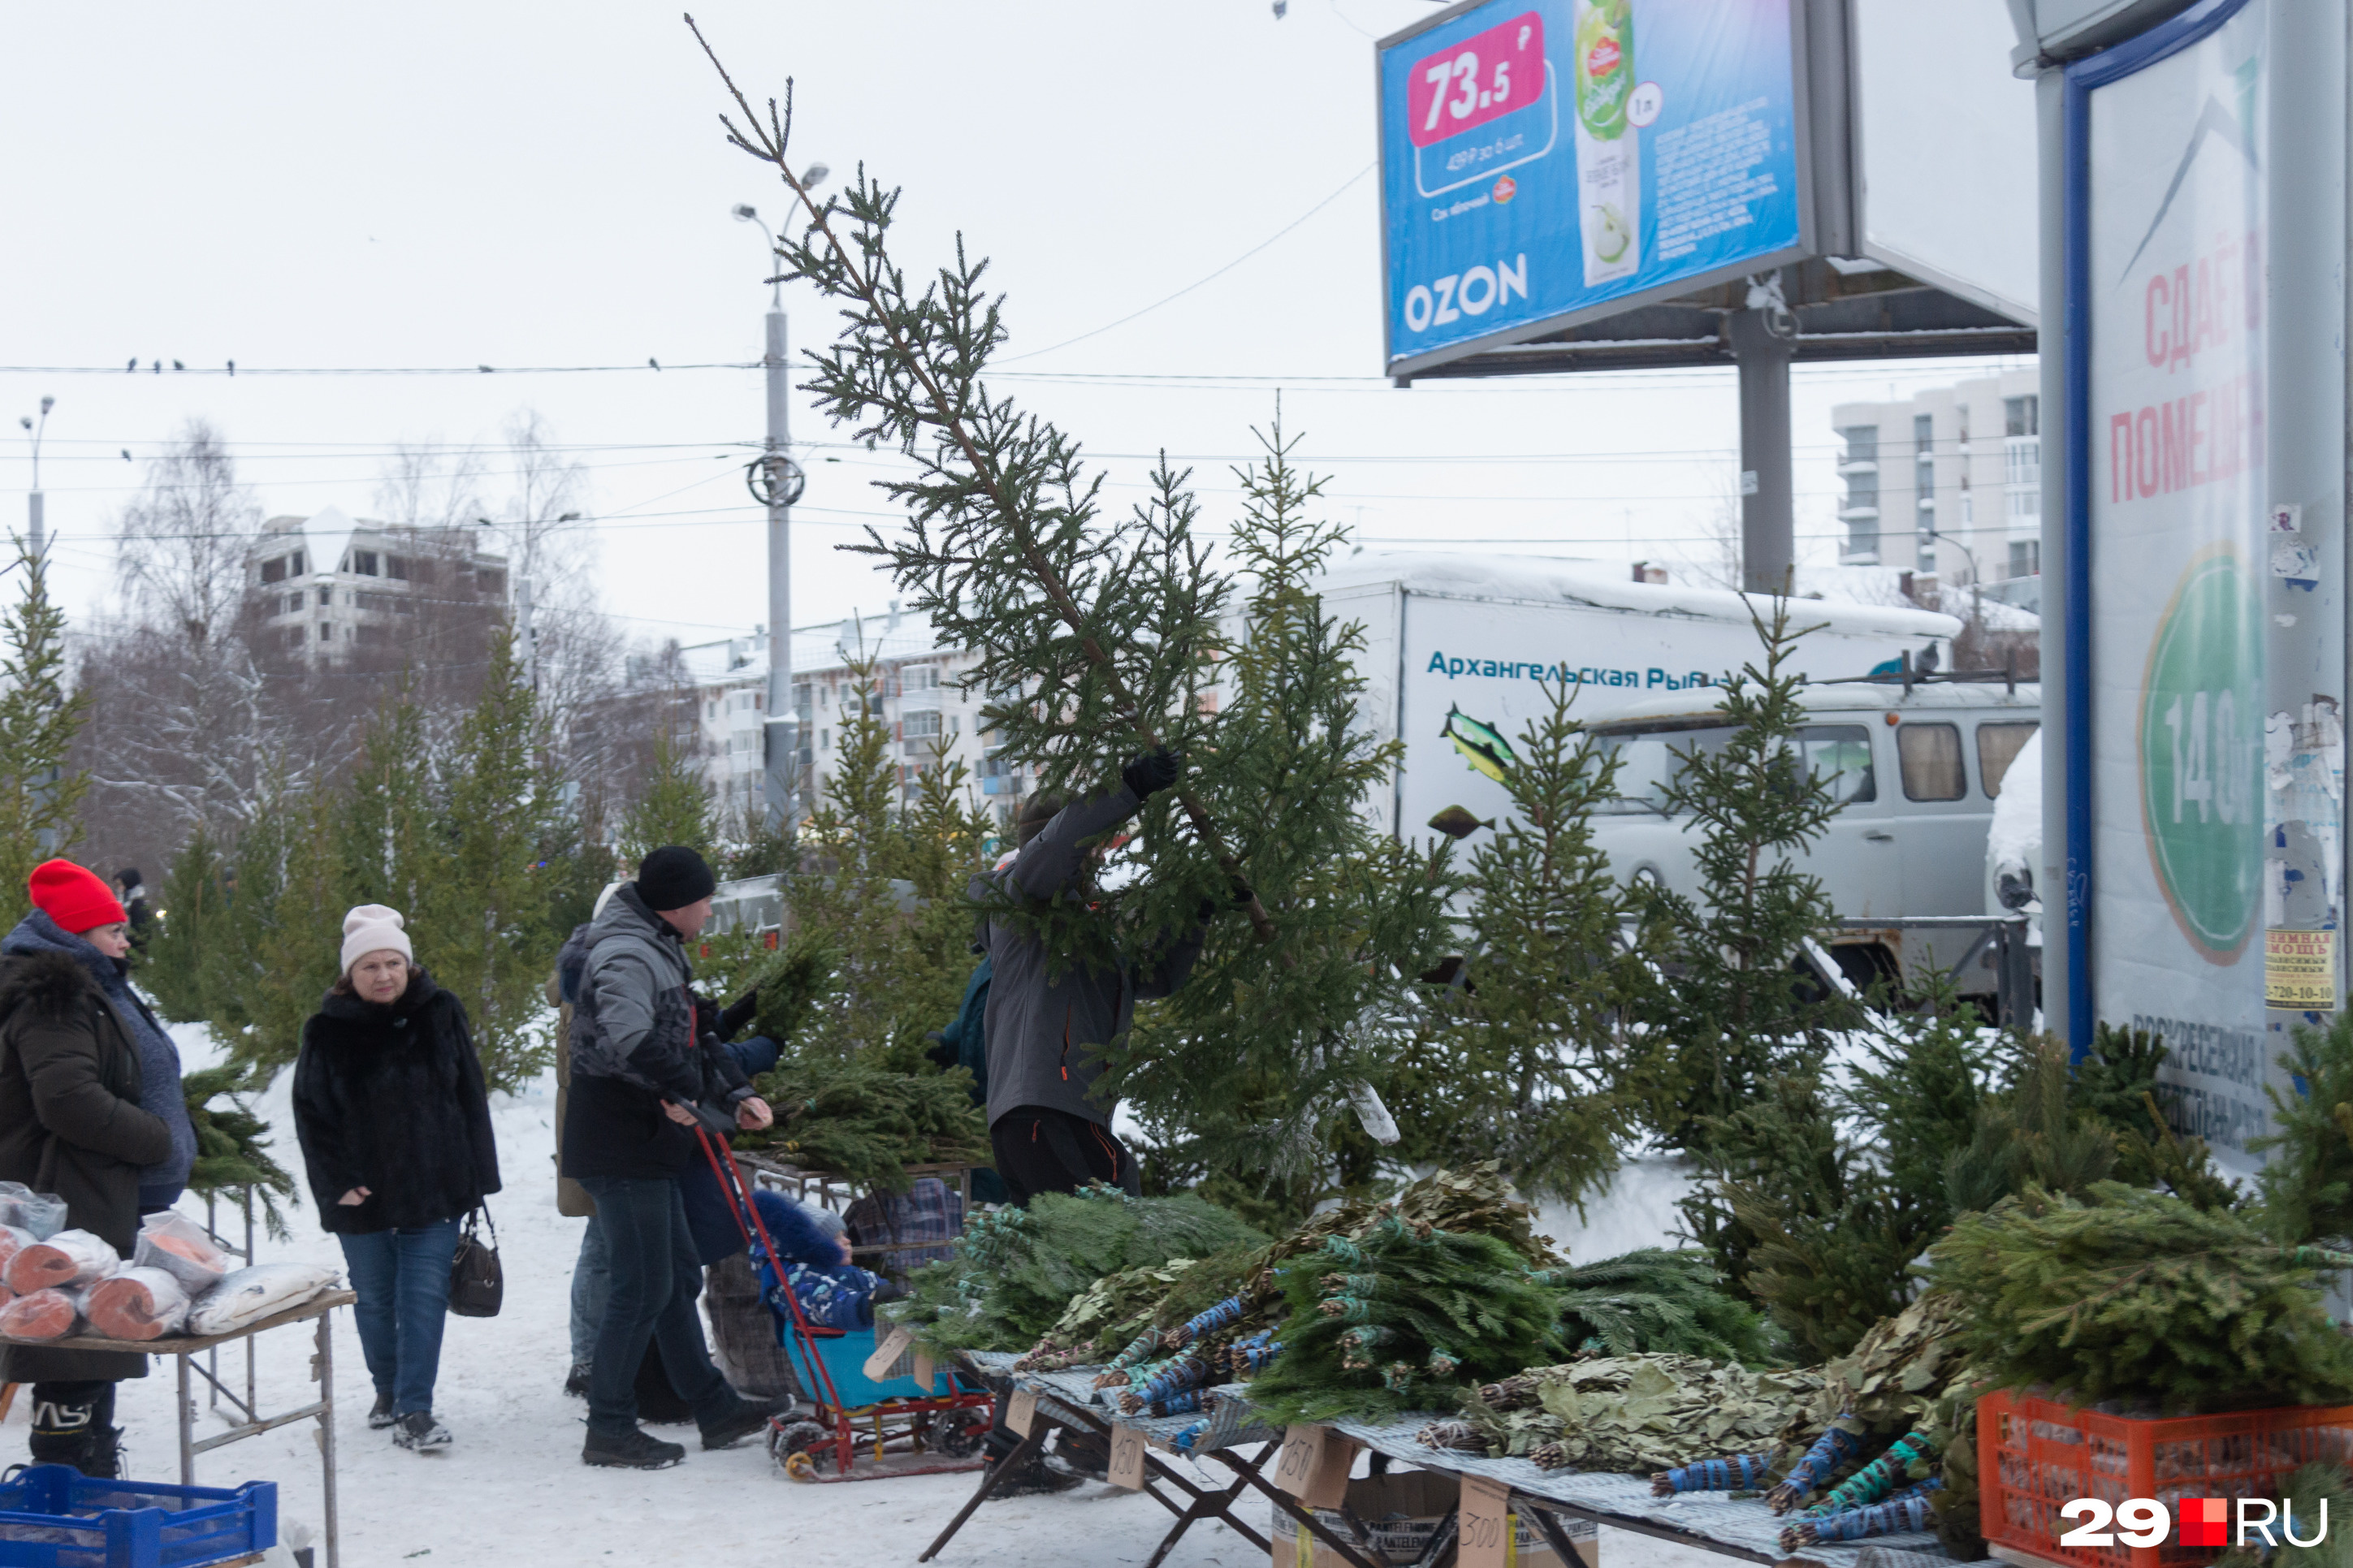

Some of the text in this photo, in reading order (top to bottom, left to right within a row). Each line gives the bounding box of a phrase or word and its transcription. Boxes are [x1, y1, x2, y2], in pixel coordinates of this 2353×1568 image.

[1424, 51, 1510, 131] 73.5
[1404, 253, 1527, 332] OZON
[1427, 650, 1638, 687] Архангельская
[1113, 1435, 1137, 1475] 150
[1281, 1436, 1314, 1481] 150
[1460, 1512, 1499, 1548] 300
